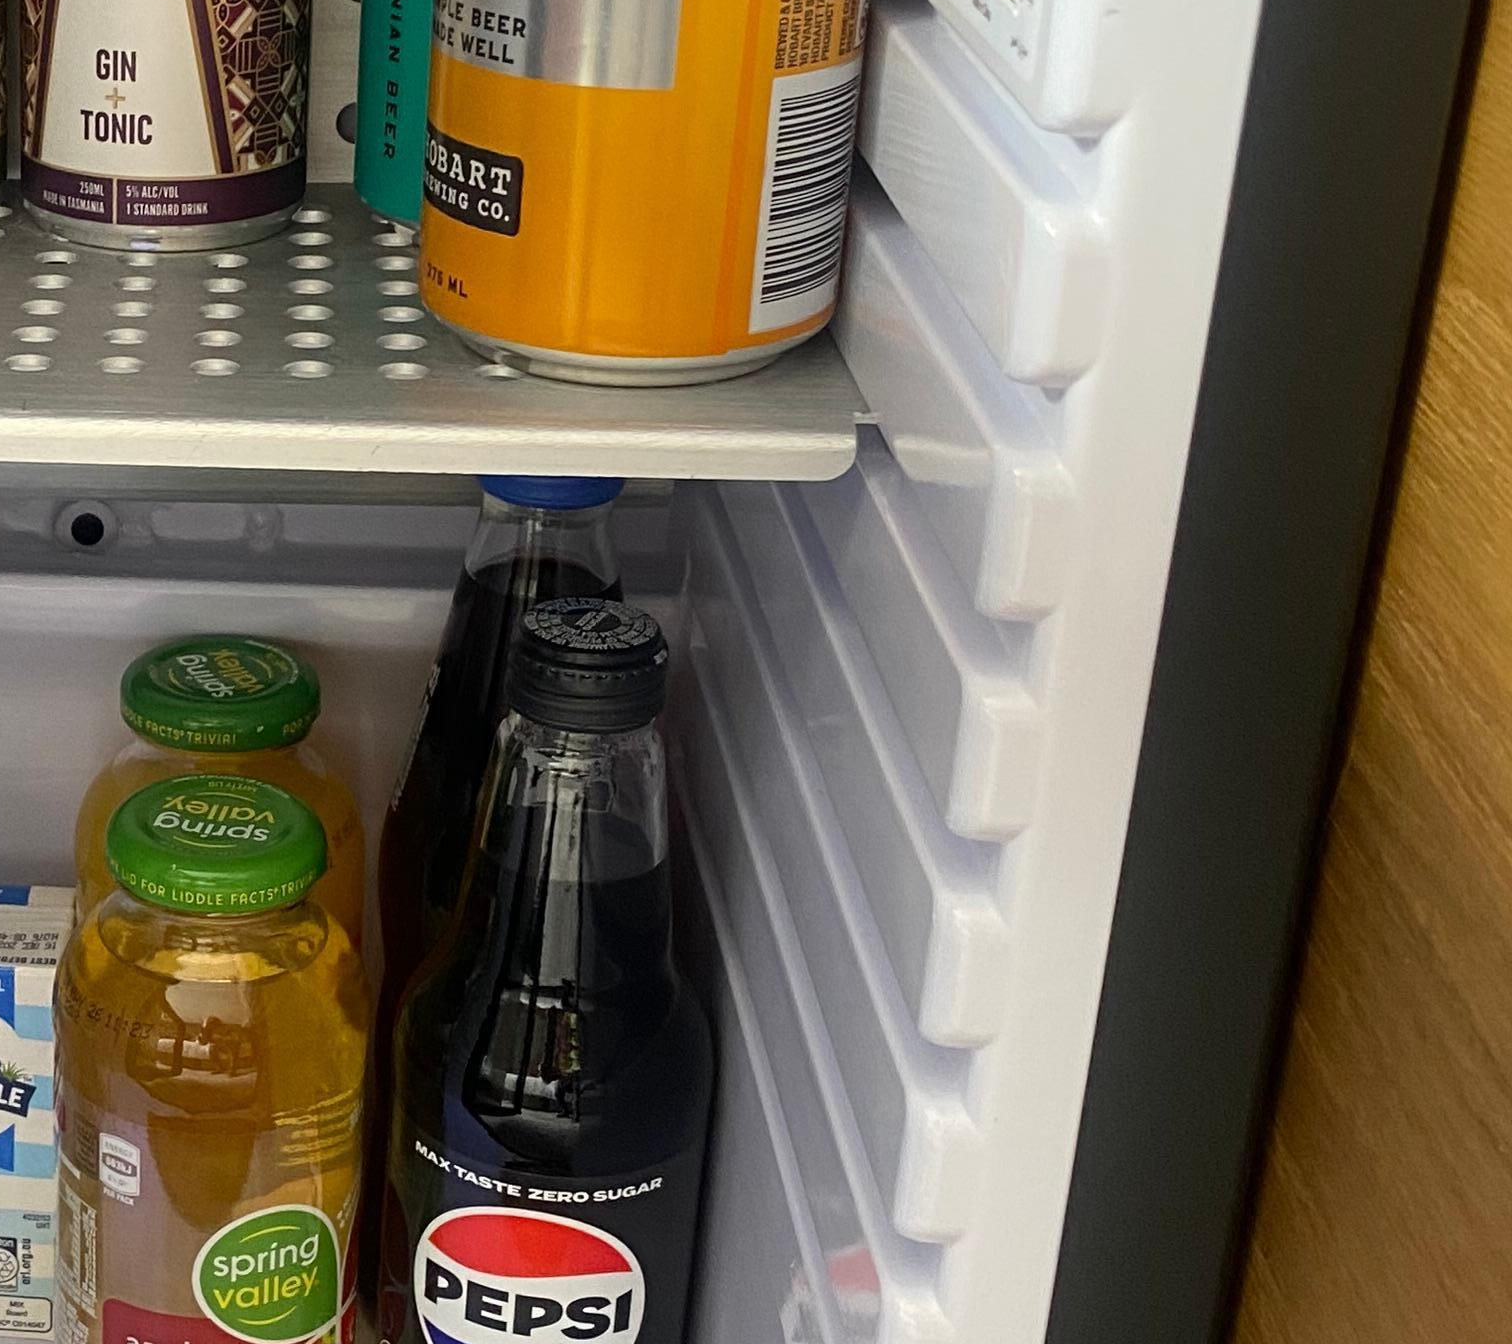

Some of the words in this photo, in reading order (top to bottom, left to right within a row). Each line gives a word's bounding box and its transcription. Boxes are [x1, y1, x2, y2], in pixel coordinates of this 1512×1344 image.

[471, 8, 526, 38] BEER
[461, 32, 514, 64] WELL
[786, 17, 802, 69] HOBART
[95, 48, 137, 83] GIN
[80, 109, 153, 146] TONIC
[383, 80, 400, 159] BEER
[426, 134, 511, 195] OBART
[79, 180, 105, 196] 250ML
[126, 185, 139, 198] 5%
[141, 185, 179, 199] ALC/VOL
[426, 172, 468, 211] EWING
[477, 199, 510, 222] CO.
[133, 203, 180, 216] STANDARD
[181, 203, 208, 215] DRINK
[448, 274, 468, 298] ML
[176, 654, 234, 698] spring
[208, 648, 265, 694] valley
[153, 811, 270, 841] spring
[162, 794, 275, 824] valley
[141, 878, 166, 897] FOR
[171, 888, 225, 906] LIDDLE
[415, 1140, 451, 1173] MAX
[453, 1165, 522, 1197] TASTE
[528, 1188, 589, 1203] ZERO
[593, 1177, 663, 1202] SUGAR
[213, 1233, 320, 1283] spring
[213, 1266, 319, 1310] valley
[423, 1257, 633, 1340] PEPSI
